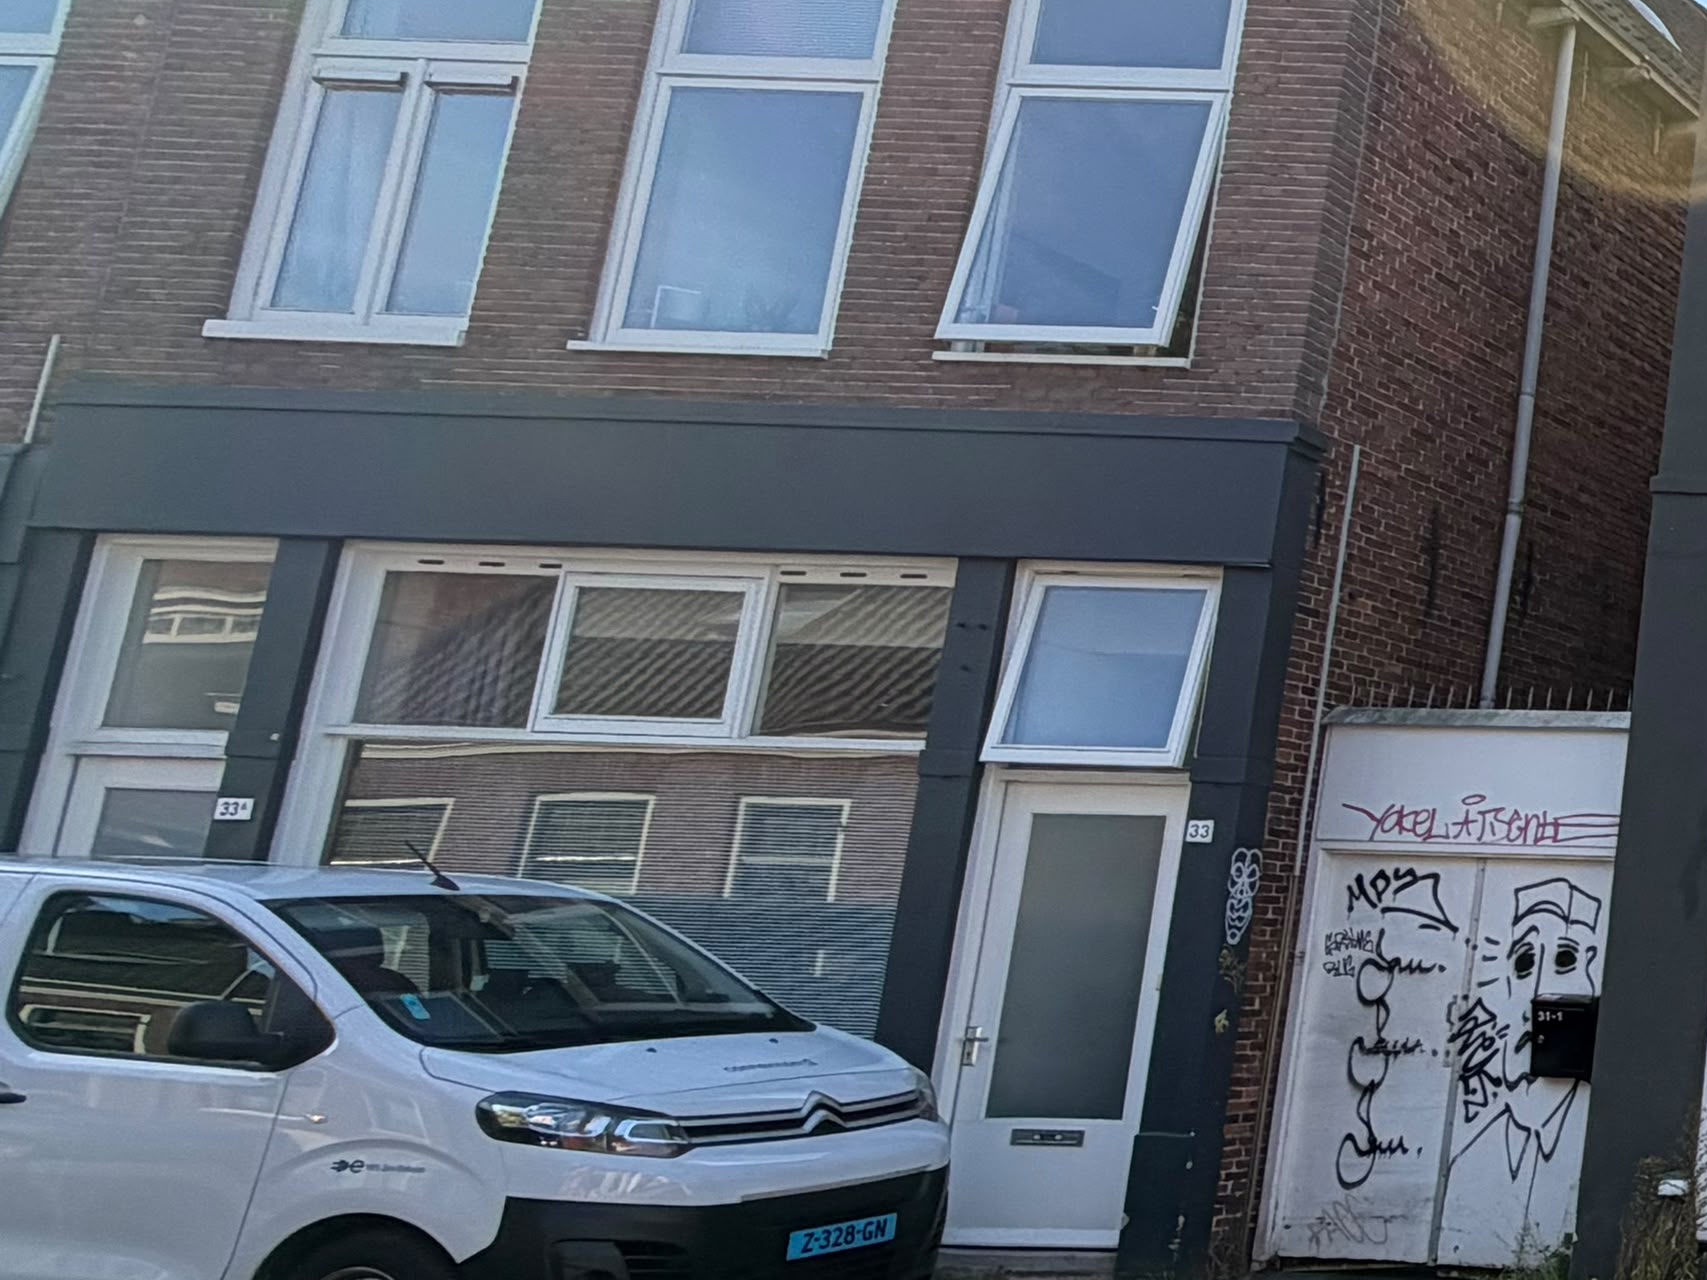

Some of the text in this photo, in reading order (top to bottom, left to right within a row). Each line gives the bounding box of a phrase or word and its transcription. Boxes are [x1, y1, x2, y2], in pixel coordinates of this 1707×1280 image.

[1189, 824, 1210, 838] 33
[1537, 1010, 1563, 1021] 31-1
[801, 1218, 889, 1254] Z-328-GN
